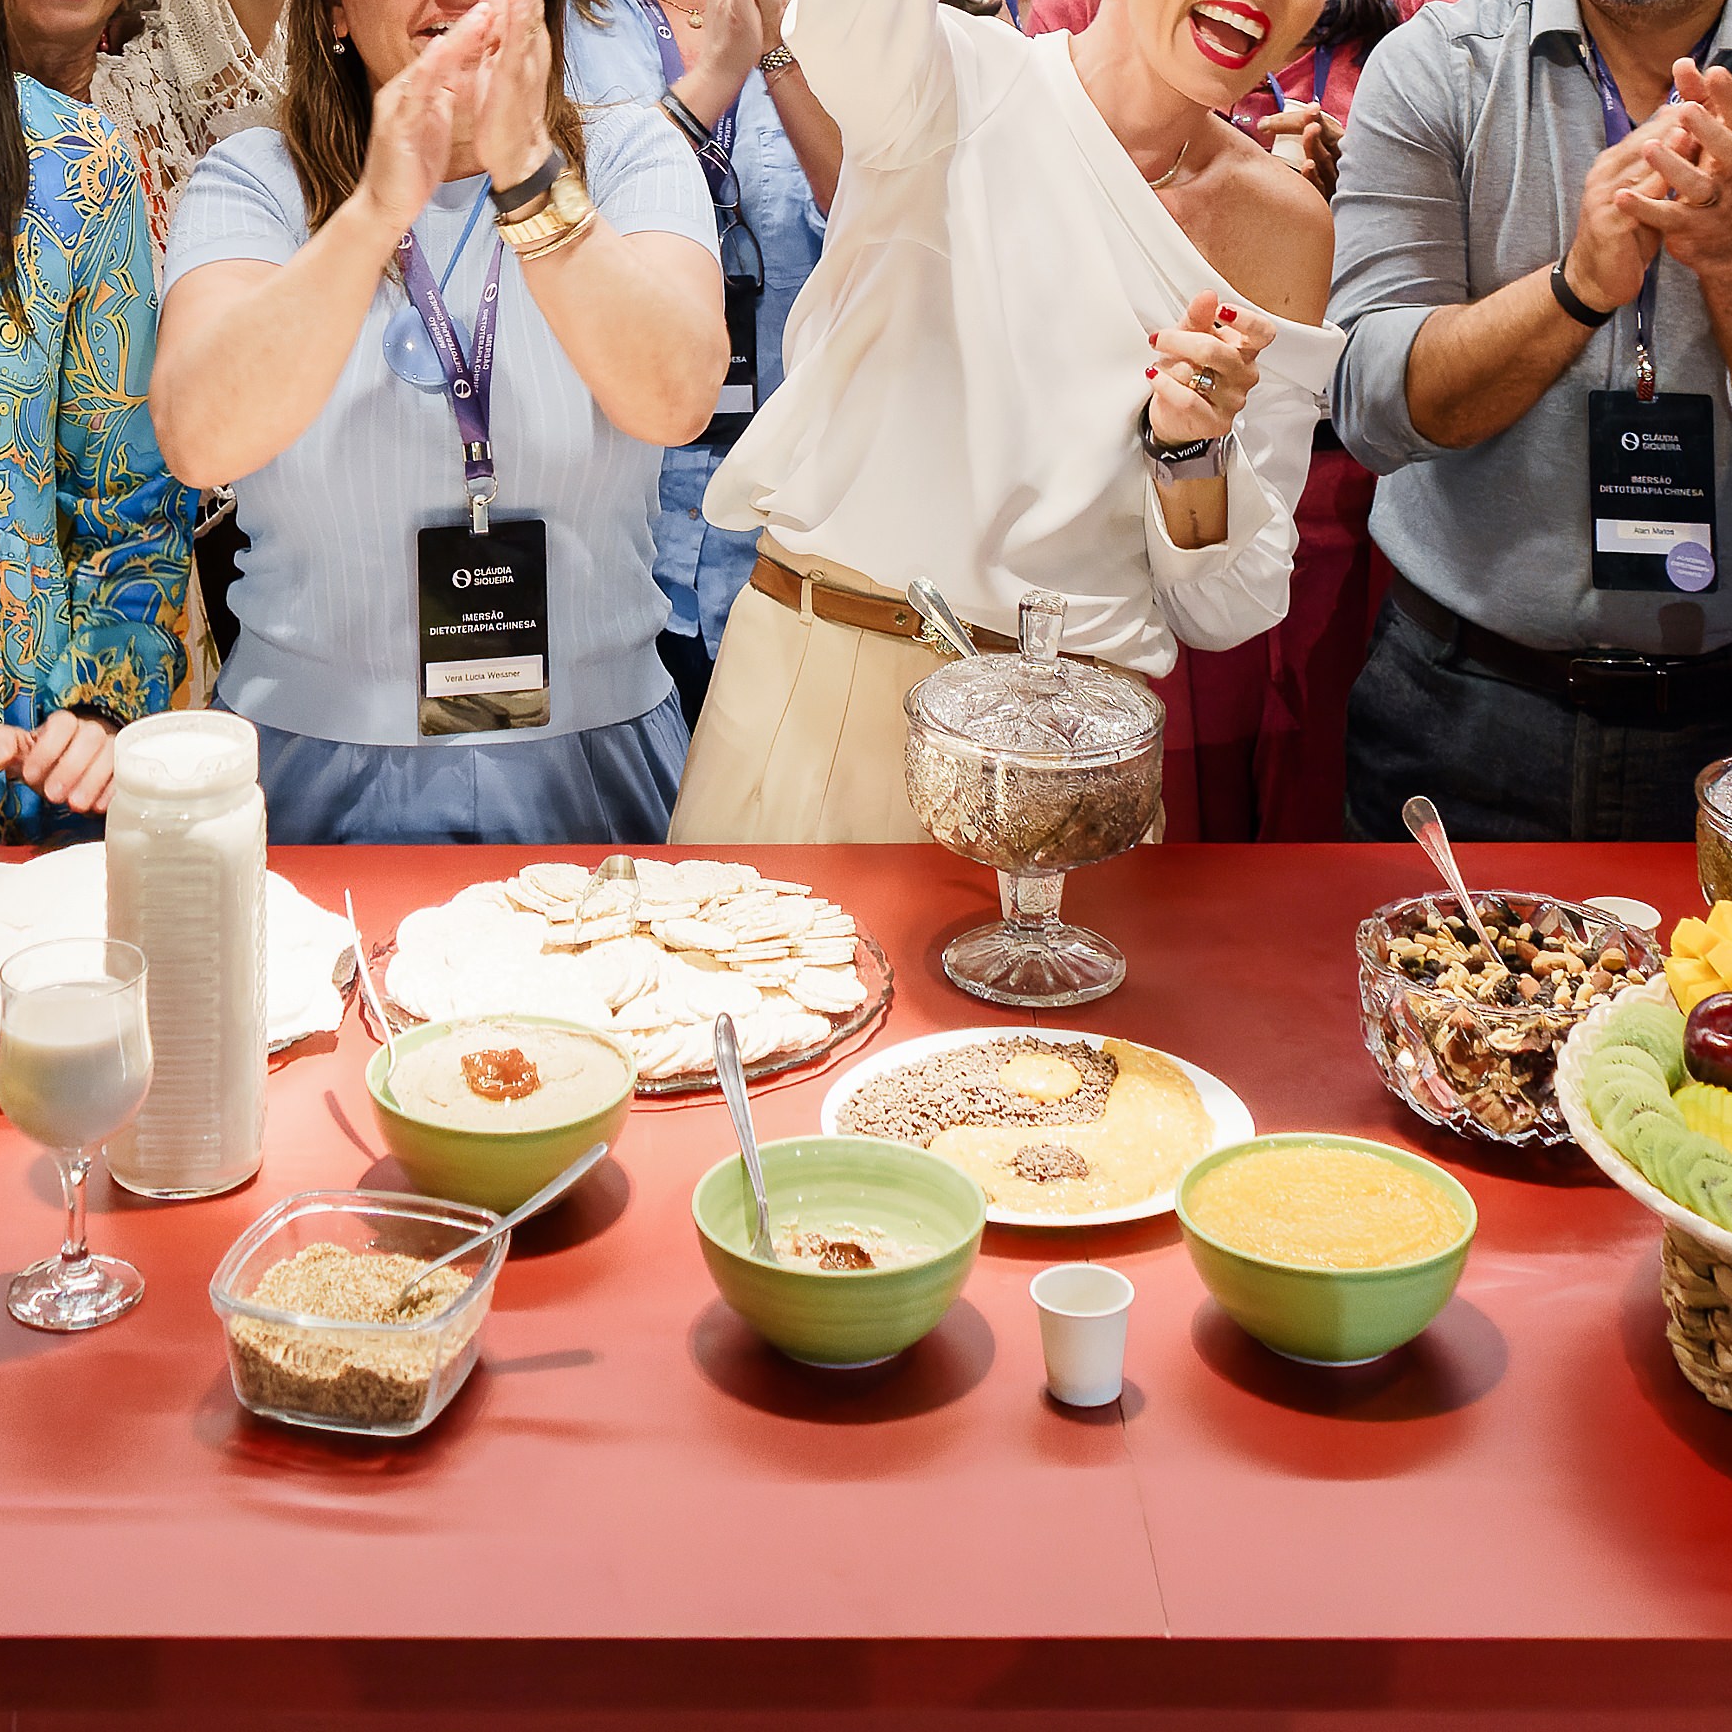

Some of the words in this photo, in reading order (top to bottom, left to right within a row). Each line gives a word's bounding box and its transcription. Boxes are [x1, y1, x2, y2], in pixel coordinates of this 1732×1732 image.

[473, 566, 512, 577] CLÁUDIA
[473, 575, 514, 586] SIQUEIRA
[462, 610, 504, 622] IMERSÃO
[429, 623, 495, 636] DIETOTERAPIA
[495, 620, 537, 631] CHINESA
